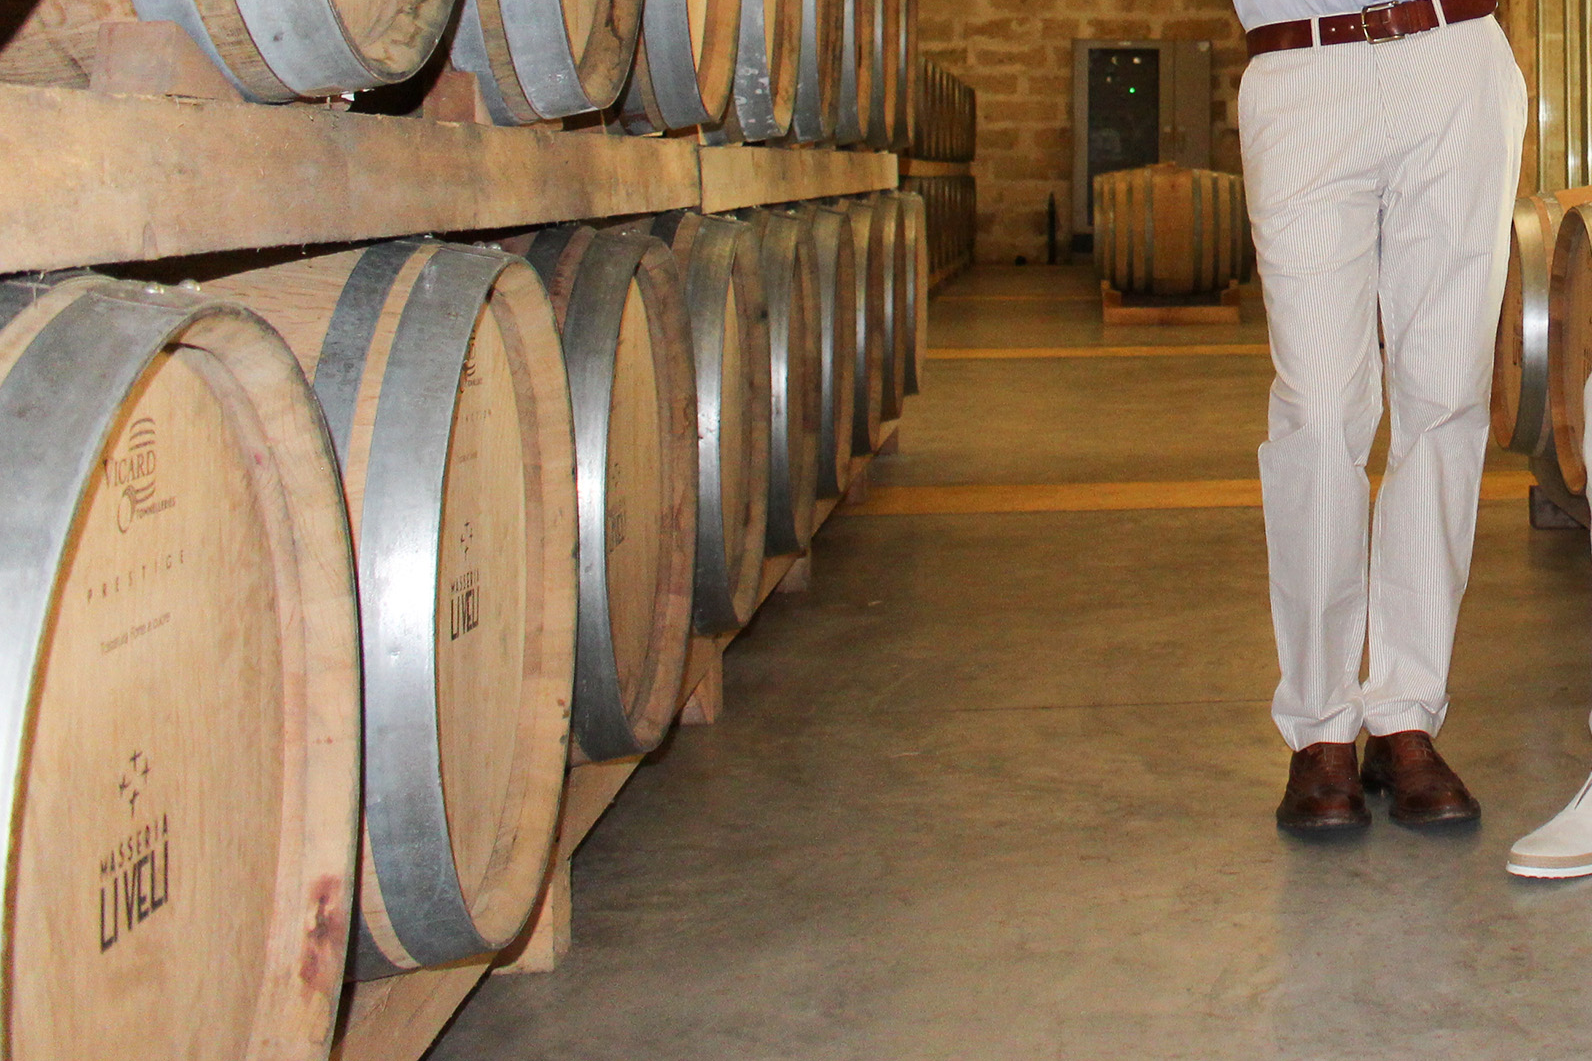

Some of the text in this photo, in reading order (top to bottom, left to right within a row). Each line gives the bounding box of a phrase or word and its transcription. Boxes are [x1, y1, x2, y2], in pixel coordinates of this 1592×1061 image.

[102, 449, 157, 489] VICARD
[87, 549, 184, 605] PRESTIGE
[100, 812, 169, 876] MASSERIA
